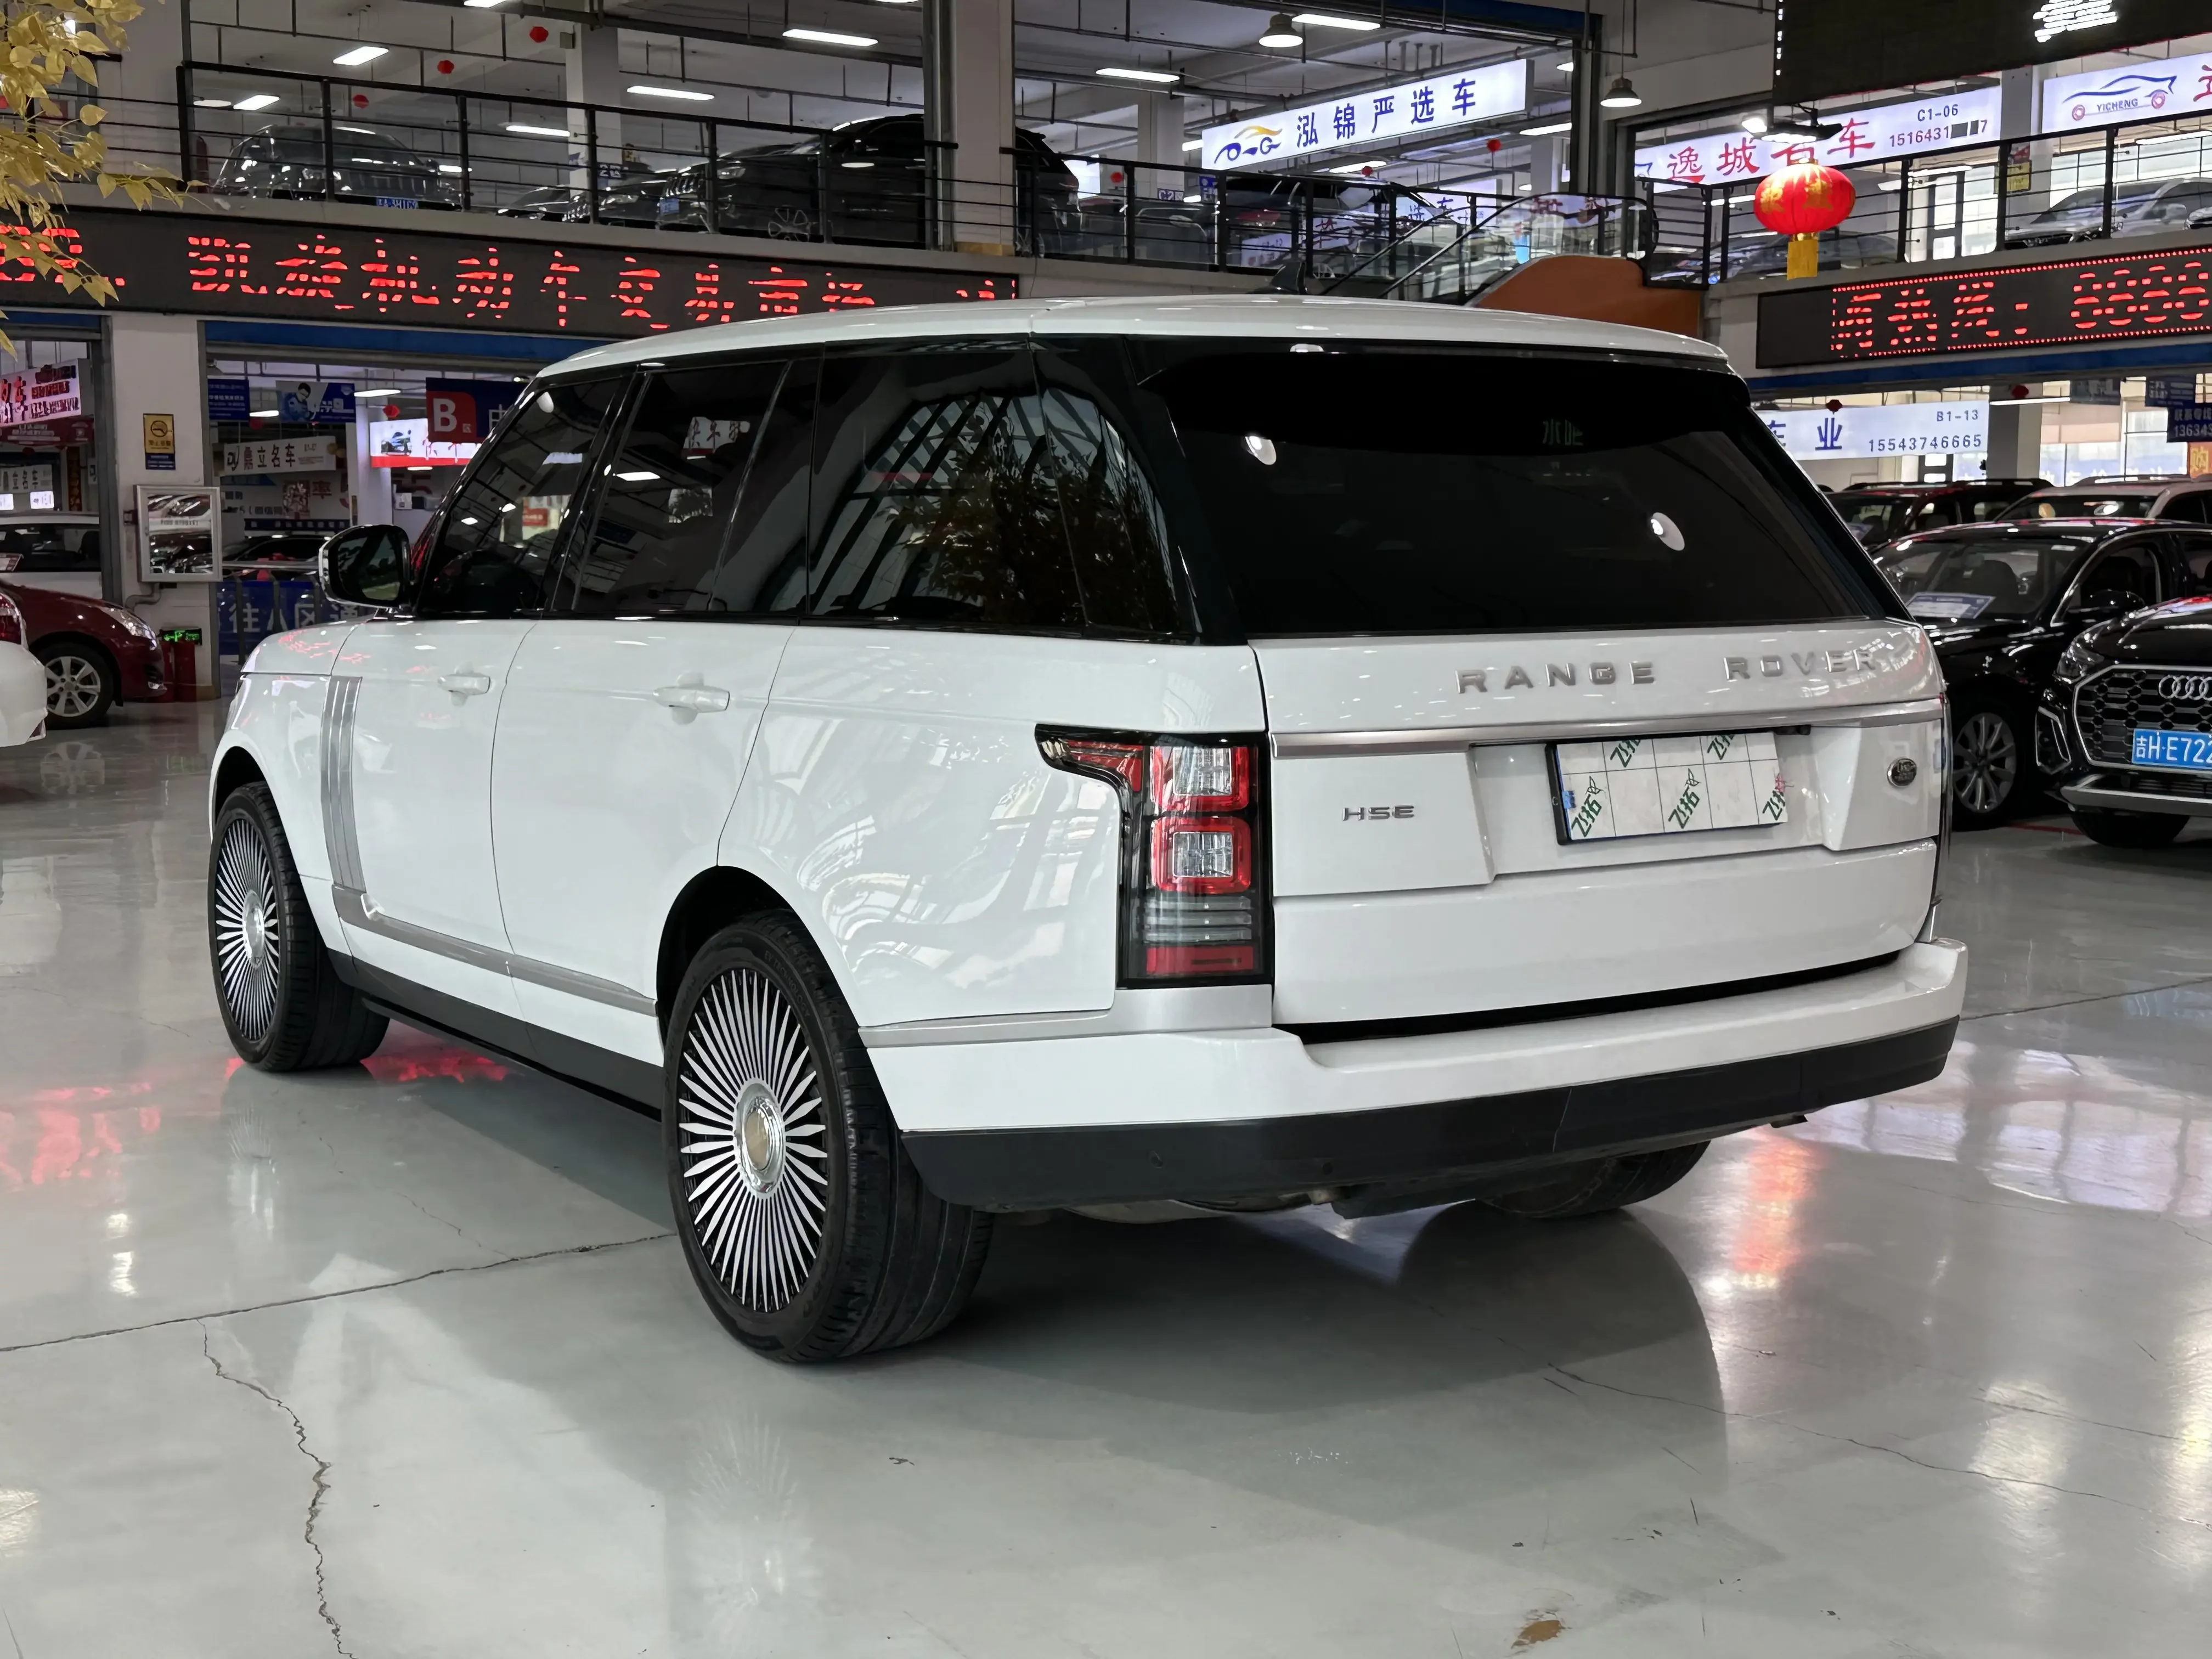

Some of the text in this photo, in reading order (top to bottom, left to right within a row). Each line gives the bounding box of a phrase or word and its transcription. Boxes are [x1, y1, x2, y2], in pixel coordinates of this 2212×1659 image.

[1296, 78, 1476, 148] 泓锦严选车
[1917, 104, 1959, 122] C1-06
[2096, 98, 2138, 112] YICHENG
[1889, 119, 1988, 147] 15164317
[1936, 410, 1979, 422] B1-13
[1869, 433, 1982, 453] 15543746665
[1457, 650, 1877, 694] RANGE ROVER
[1342, 804, 1415, 821] HSE
